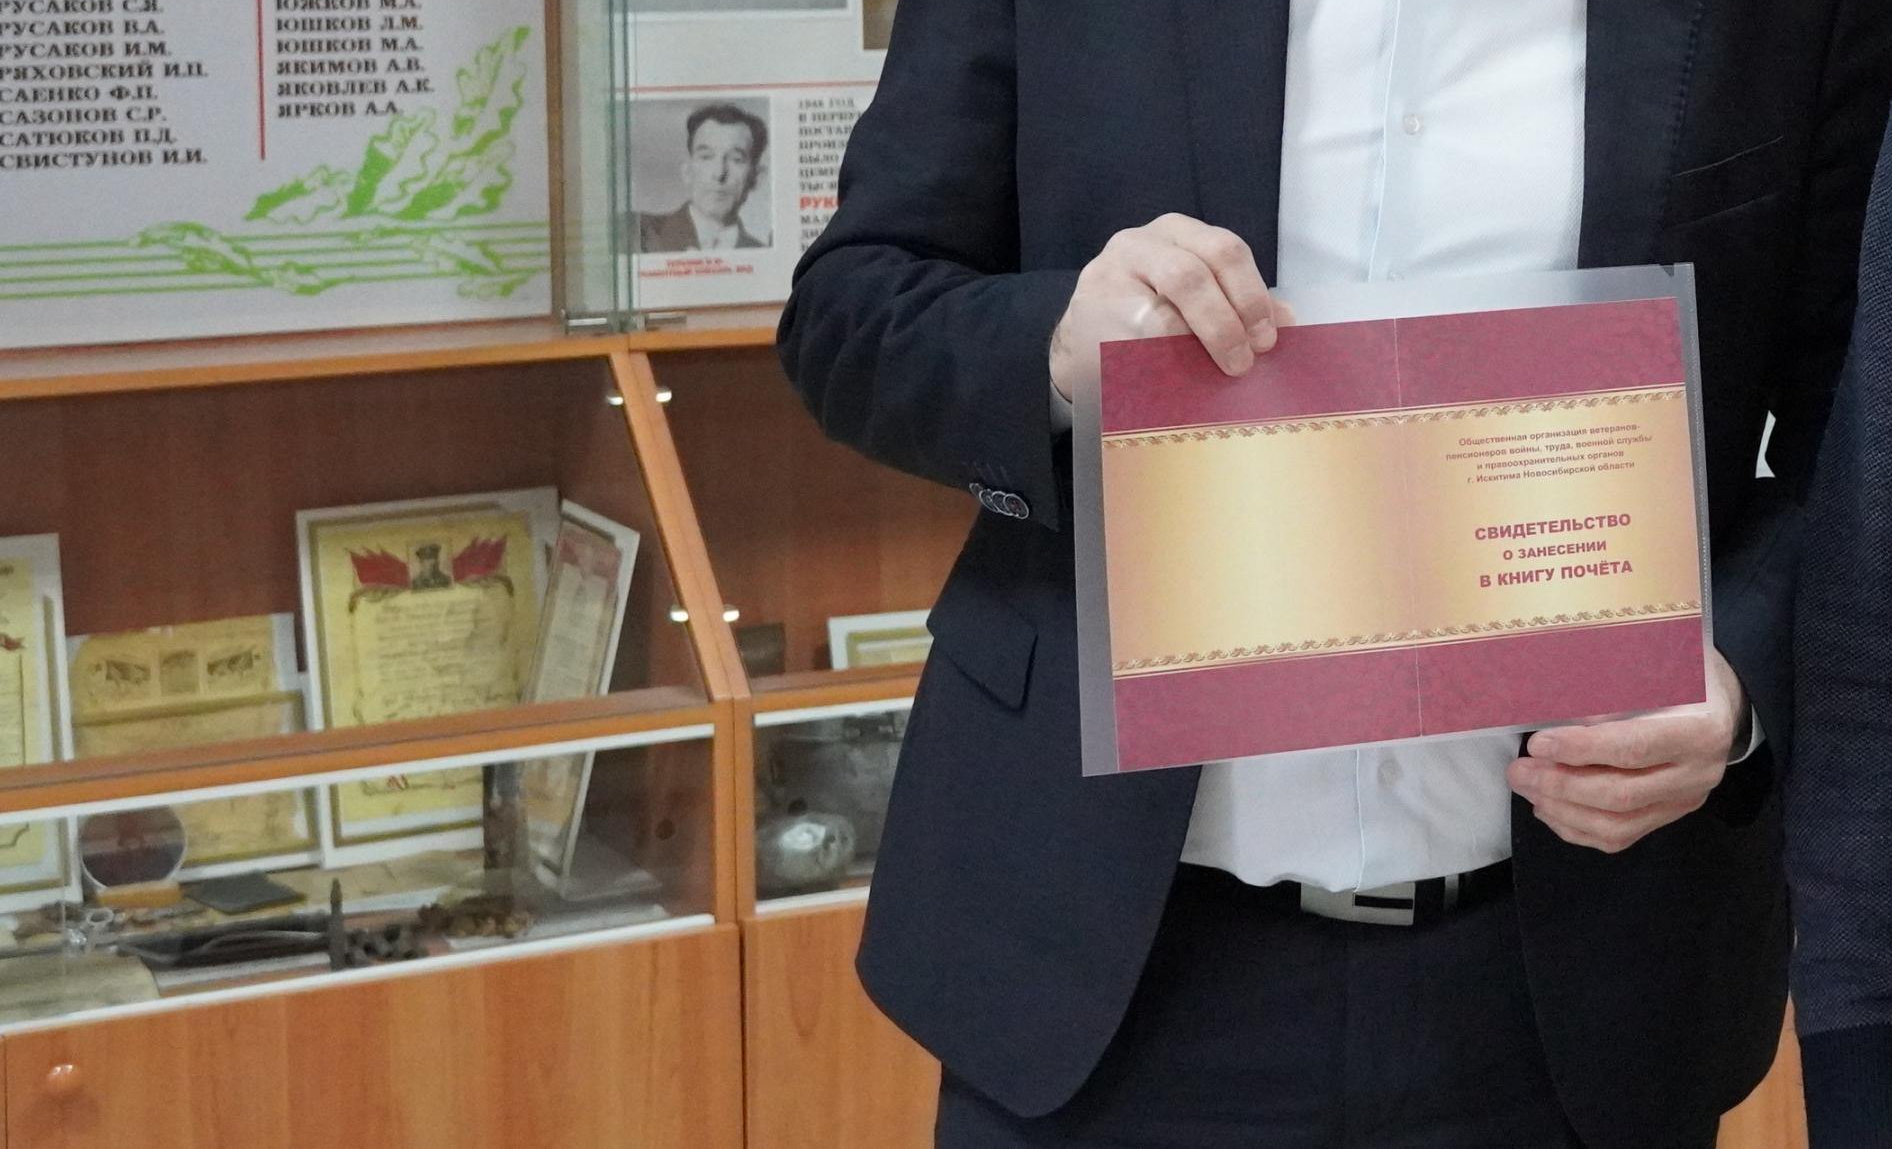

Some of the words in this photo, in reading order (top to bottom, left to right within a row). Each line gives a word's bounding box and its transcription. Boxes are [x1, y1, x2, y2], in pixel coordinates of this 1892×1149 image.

[274, 16, 372, 32] ЮШКОВ
[275, 37, 373, 54] ЮШКОВ
[275, 58, 379, 75] ЯКИМОВ
[276, 79, 389, 97] ЯКОВЛЕВ
[276, 101, 357, 118] ЯРКОВ
[0, 150, 154, 169] СВИСТУНОВ
[1458, 433, 1528, 446] Общественная
[1529, 427, 1587, 442] организация
[1589, 423, 1640, 435] ветеранов-
[1446, 449, 1507, 461] пенсионеров
[1509, 444, 1543, 455] войны,
[1545, 441, 1573, 453] труда,
[1576, 437, 1614, 448] военной
[1616, 434, 1652, 447] службы
[1485, 455, 1585, 470] правоохранительных
[1587, 450, 1624, 462] органов
[1476, 471, 1521, 483] Искитима
[1523, 463, 1595, 479] Новосибирской
[1597, 461, 1635, 472] области
[1474, 513, 1632, 540] СВИДЕТЕЛЬСТВО
[1518, 540, 1607, 559] ЗАНЕСЕНИИ
[1479, 574, 1492, 588] В
[1497, 567, 1555, 587] КНИГУ
[1561, 560, 1633, 580] ПОЧЁТА
